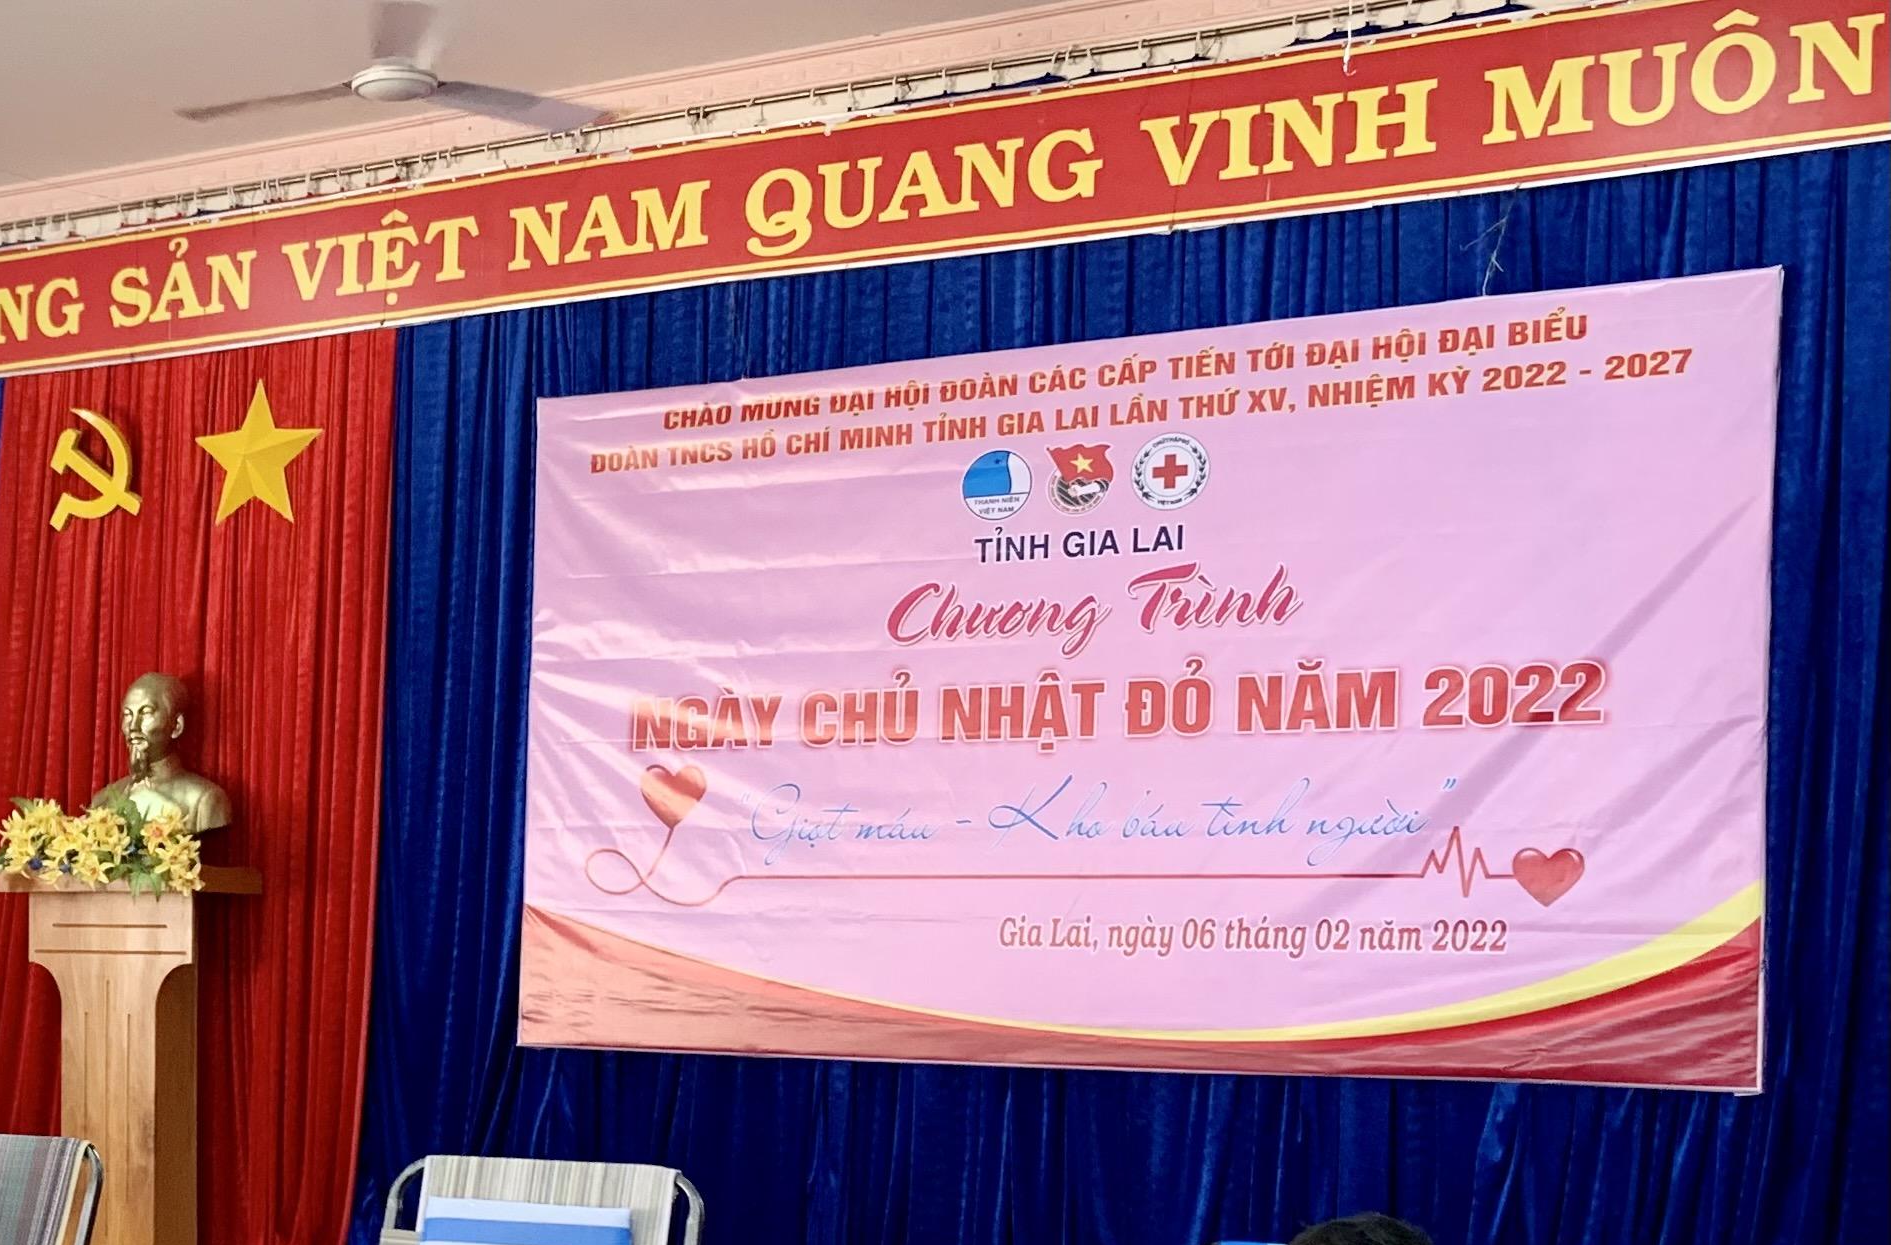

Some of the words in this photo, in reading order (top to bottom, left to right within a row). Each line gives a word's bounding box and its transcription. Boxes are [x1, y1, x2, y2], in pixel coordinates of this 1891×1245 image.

[110, 237, 277, 328] SẢN
[280, 212, 478, 303] VIỆT
[509, 180, 710, 271] NAM
[745, 127, 1103, 256] QUANG
[1140, 77, 1437, 187] VINH
[1482, 9, 1885, 145] MUÔN
[590, 447, 658, 473] ĐOÀN
[668, 442, 732, 466] TNCS
[742, 428, 776, 460] HỒ
[786, 427, 830, 455] CHÍ
[840, 422, 913, 450] MINH
[923, 412, 986, 443] TỈNH
[997, 410, 1044, 436] GIA
[1056, 405, 1099, 430] LAI
[1110, 393, 1167, 425] LẦN
[1178, 389, 1240, 419] THỨ
[1247, 386, 1295, 413] XV,
[1308, 374, 1415, 408] NHIỆM
[1428, 366, 1471, 397] KỲ
[1482, 361, 1566, 392] 2022
[1604, 348, 1692, 380] 2027
[664, 402, 731, 430] CHÀO
[830, 392, 874, 416] ĐẠI
[884, 380, 929, 411] HỘI
[940, 372, 1017, 402] ĐOÀN
[1029, 365, 1086, 394] CÁC
[1098, 353, 1156, 386] CẤP
[1168, 346, 1235, 379] TIẾN
[1246, 341, 1295, 372] TỚI
[1305, 339, 1359, 369] ĐẠI
[1372, 328, 1426, 362] HỘI
[1438, 325, 1495, 355] ĐẠI
[1508, 307, 1587, 346] BIỂU
[974, 527, 1049, 562] TỈNH
[1063, 530, 1119, 558] GIA
[1132, 525, 1184, 552] LAI
[885, 581, 1112, 658] Chương
[1127, 561, 1303, 633] Trình
[632, 686, 784, 750] NGÀY
[800, 670, 921, 746] CHỦ
[939, 670, 1106, 753] NHẬT
[1124, 655, 1213, 738] ĐỎ
[1235, 657, 1400, 735] NĂM
[1421, 661, 1605, 728] 2022
[988, 774, 1111, 849] Kho
[998, 917, 1044, 948] Gia
[1049, 915, 1098, 950] Lai,
[1107, 915, 1174, 957] ngày
[1181, 918, 1216, 950] 06
[1223, 915, 1307, 958] tháng
[1315, 918, 1349, 950] 02
[1358, 920, 1423, 952] năm
[1430, 918, 1507, 952] 2022
